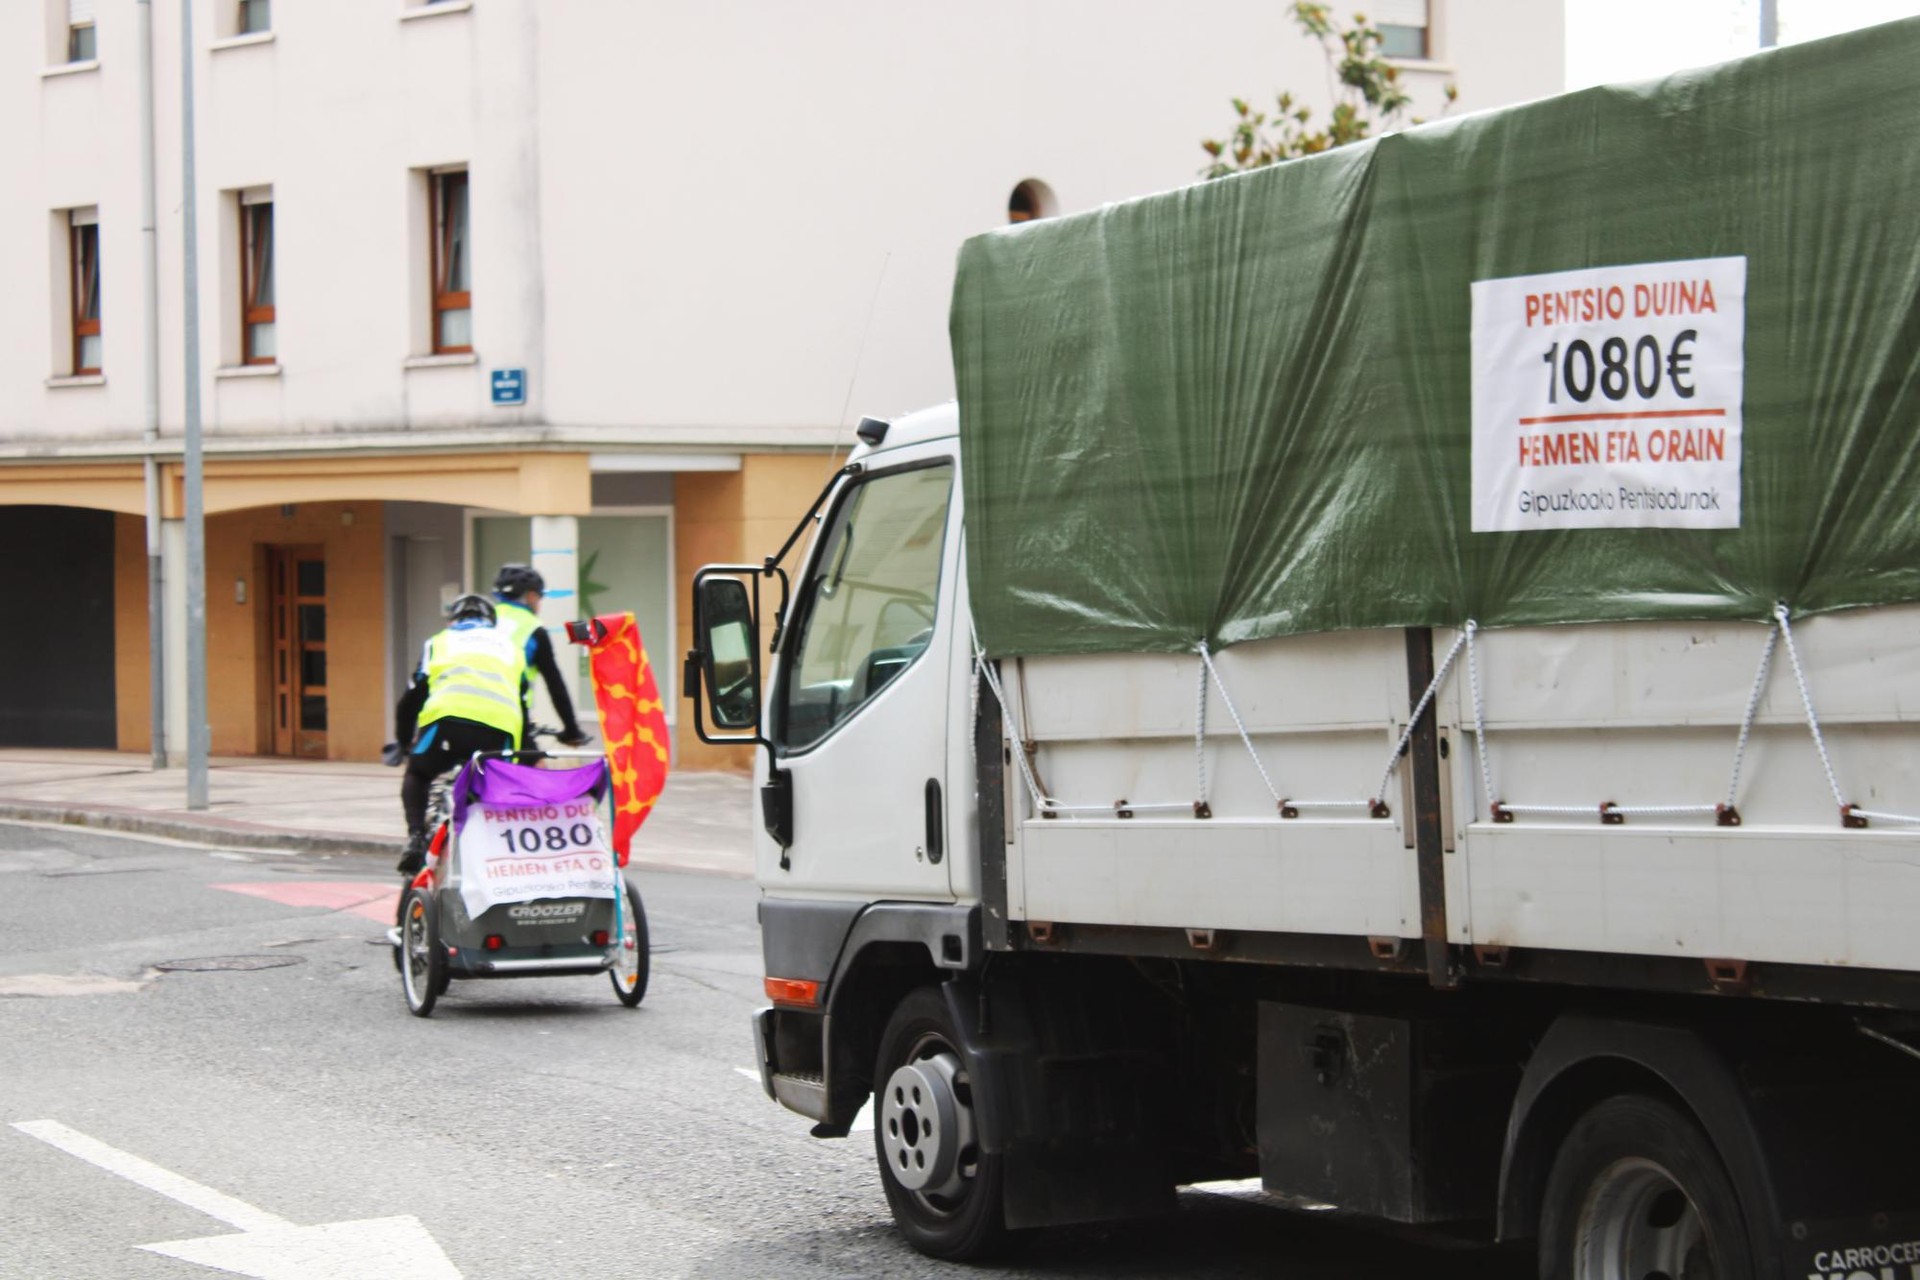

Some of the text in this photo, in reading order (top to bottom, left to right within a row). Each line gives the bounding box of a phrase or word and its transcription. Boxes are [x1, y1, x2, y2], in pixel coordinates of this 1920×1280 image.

[1525, 279, 1717, 327] PENTSIO DUINA
[1543, 329, 1698, 404] 1080€
[1519, 428, 1725, 467] HEMEN ETA ORAIN
[1519, 487, 1720, 517] Gipuzkoako Pentsiodunak
[484, 806, 558, 822] PENTSIO
[500, 823, 602, 852] 1080
[487, 863, 549, 878] HEMEN
[554, 859, 584, 873] ETA
[509, 903, 585, 917] CROOZER
